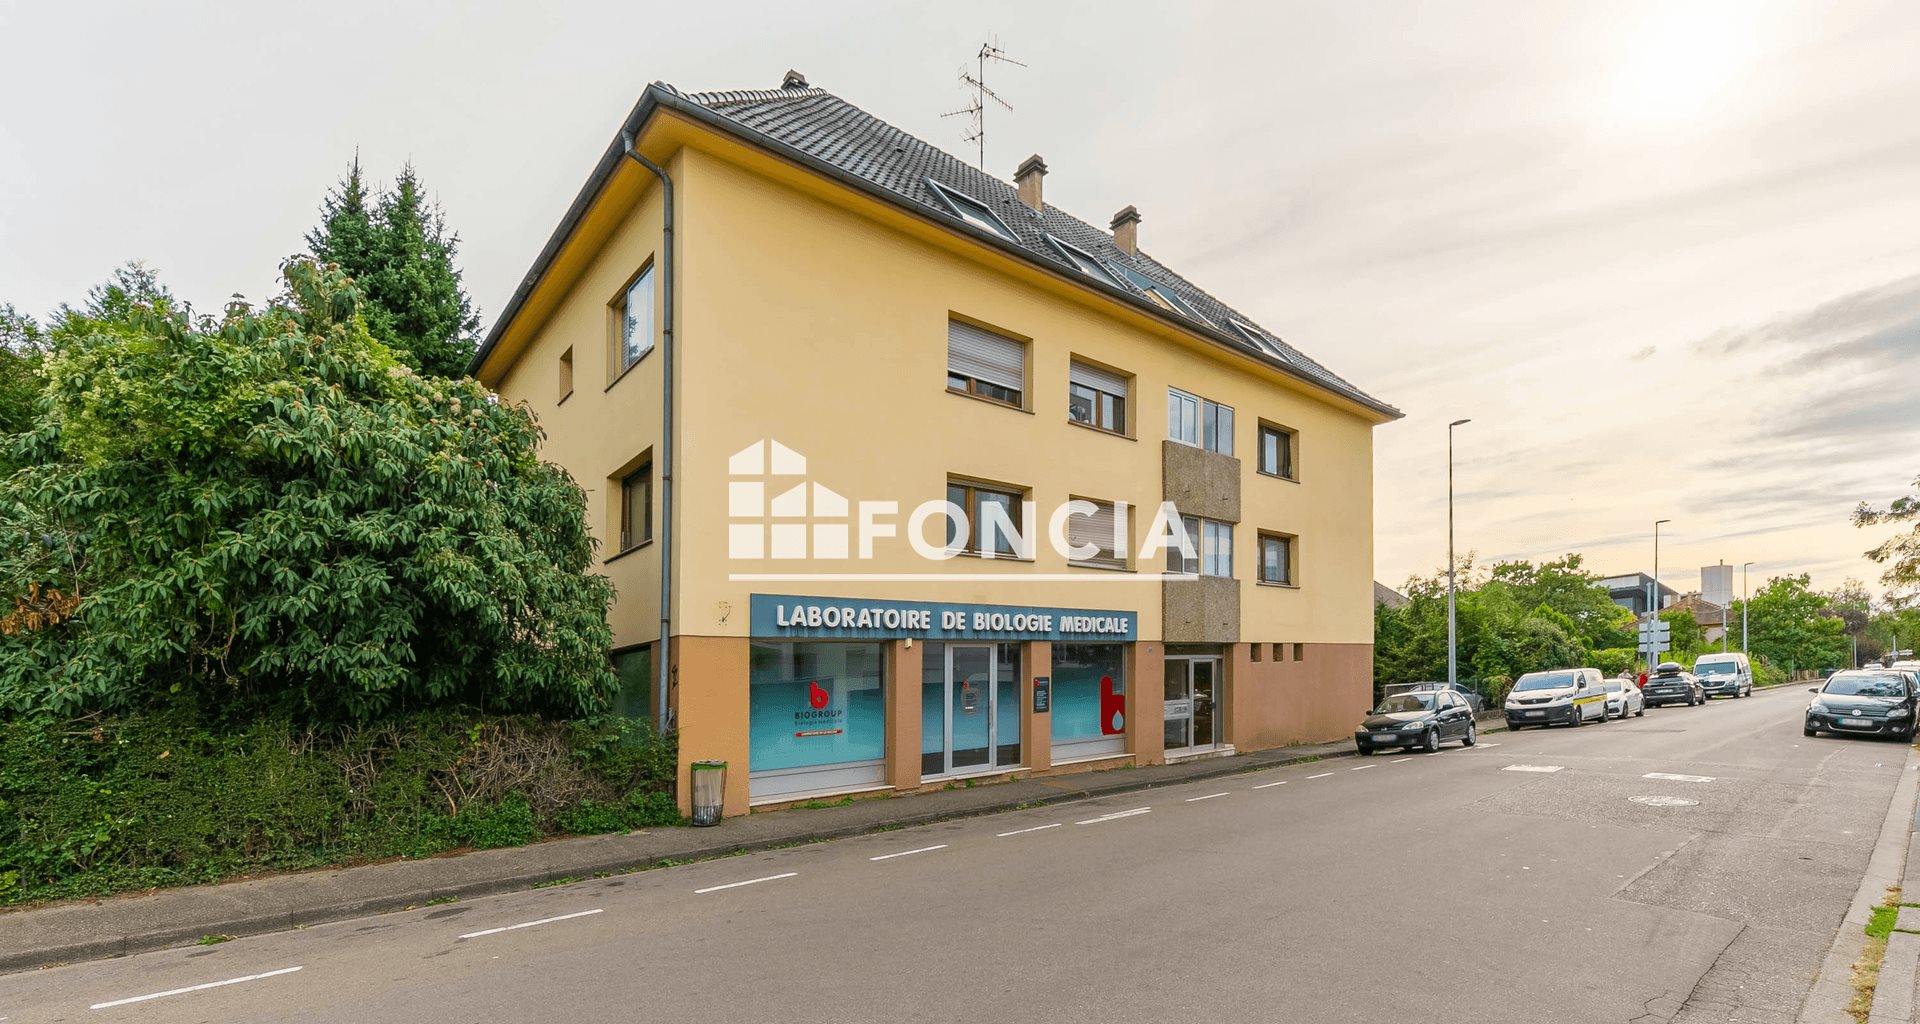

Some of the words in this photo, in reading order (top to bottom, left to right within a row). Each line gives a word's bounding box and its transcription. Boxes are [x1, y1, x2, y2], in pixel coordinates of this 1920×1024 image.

[776, 604, 931, 630] LABORATOIRE
[941, 611, 966, 631] DE
[972, 612, 1053, 633] BIOLOGIE
[1059, 616, 1129, 634] MEDICALE
[794, 710, 842, 720] BIOGROUP
